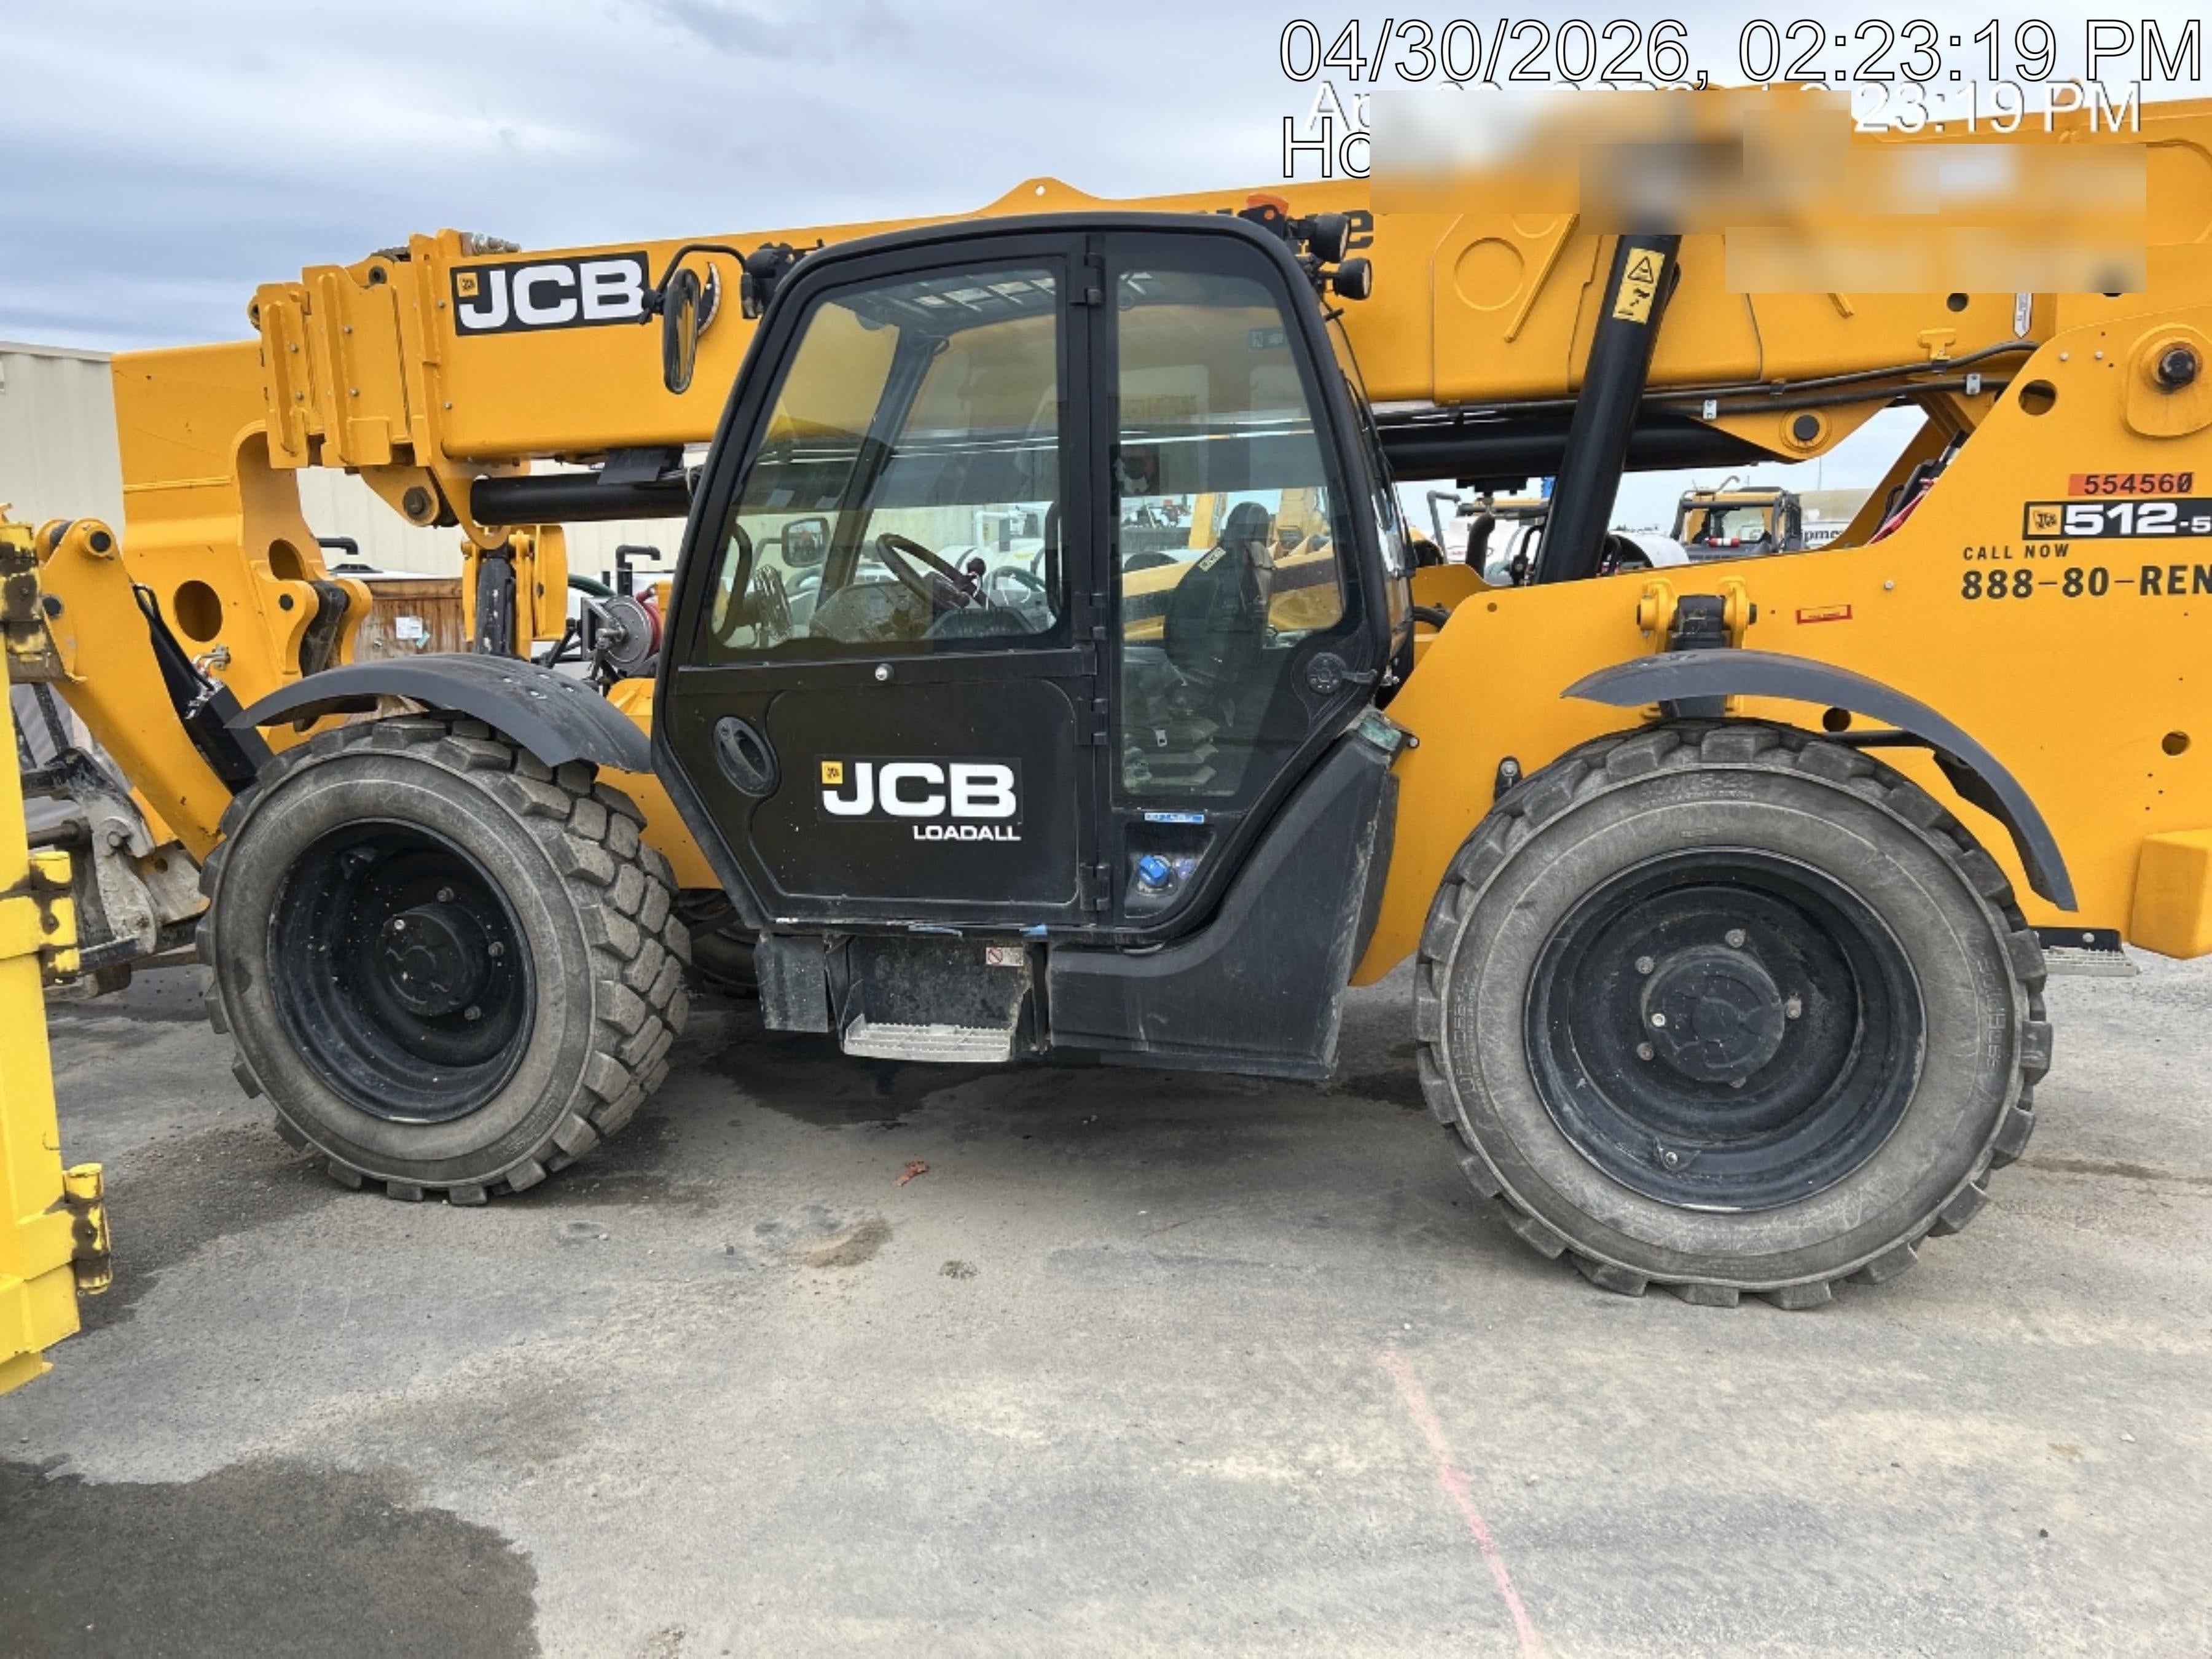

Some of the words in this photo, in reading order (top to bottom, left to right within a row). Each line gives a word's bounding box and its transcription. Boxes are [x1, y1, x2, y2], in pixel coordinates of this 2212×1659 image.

[458, 259, 643, 329] JCB
[2084, 472, 2194, 495] 554560
[1963, 546, 2014, 561] CALL
[2024, 544, 2069, 559] NOW
[822, 762, 1016, 817] JCB
[913, 825, 1021, 841] LOADALL
